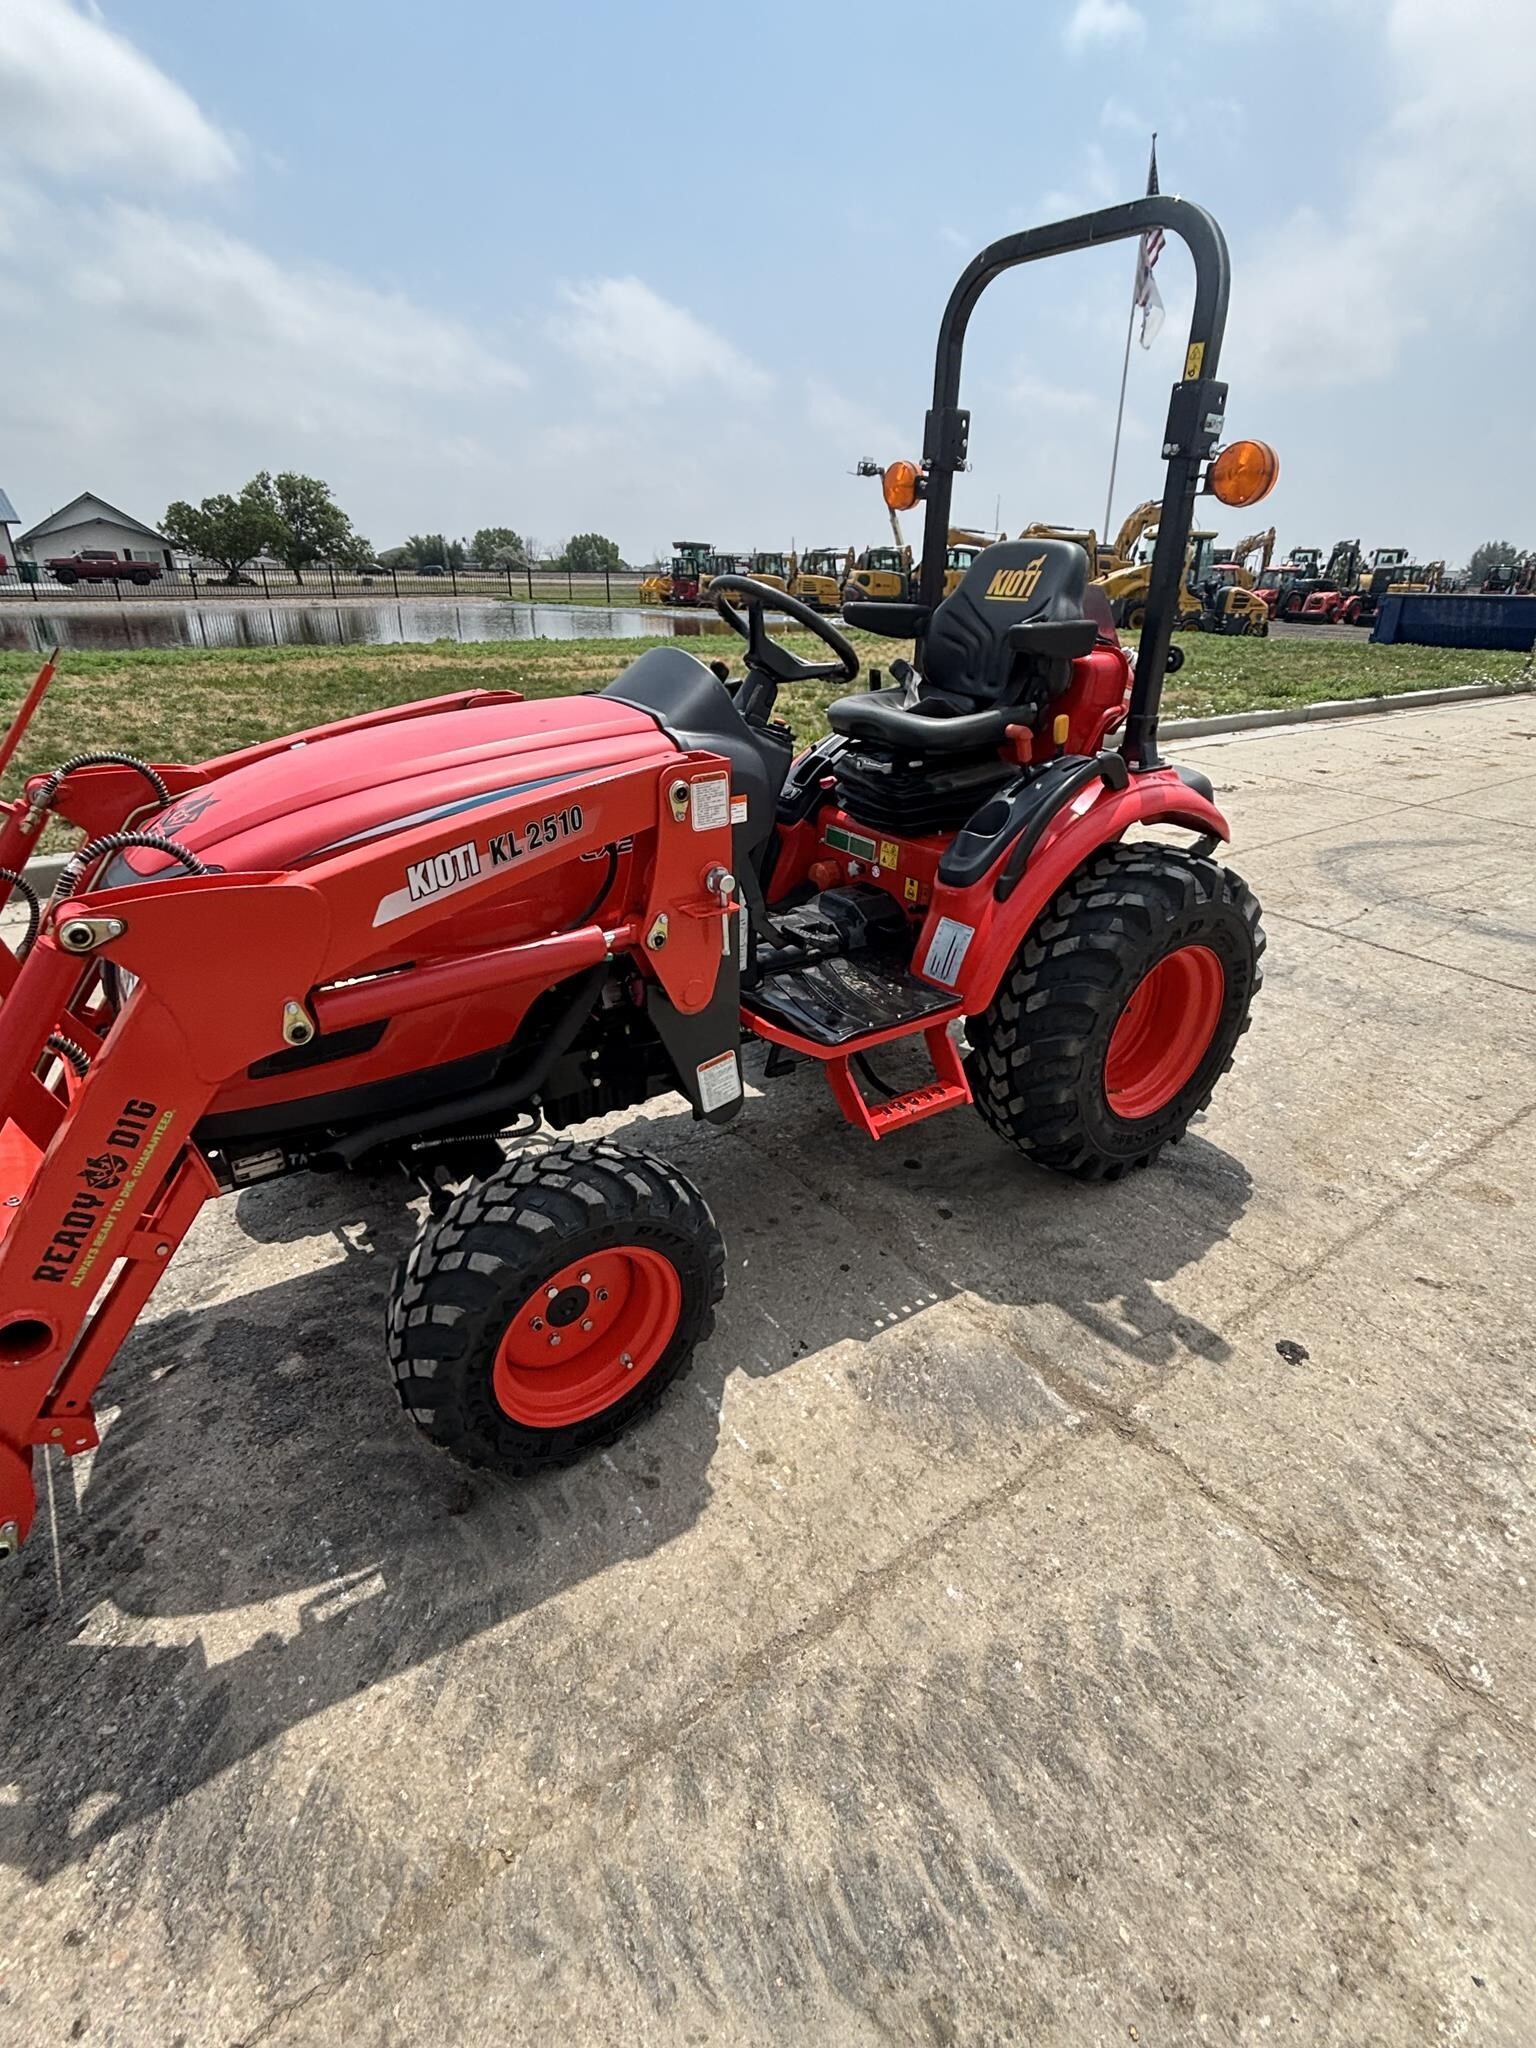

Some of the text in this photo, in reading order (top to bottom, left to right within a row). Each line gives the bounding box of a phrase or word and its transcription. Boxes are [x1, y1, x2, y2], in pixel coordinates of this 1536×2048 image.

[986, 569, 1043, 597] KIOTI
[406, 804, 585, 901] KIOTI KL 2510
[33, 1099, 158, 1282] READY DIG
[70, 1246, 100, 1288] ALWAYS
[93, 1213, 117, 1247] READY
[111, 1198, 126, 1216] TO
